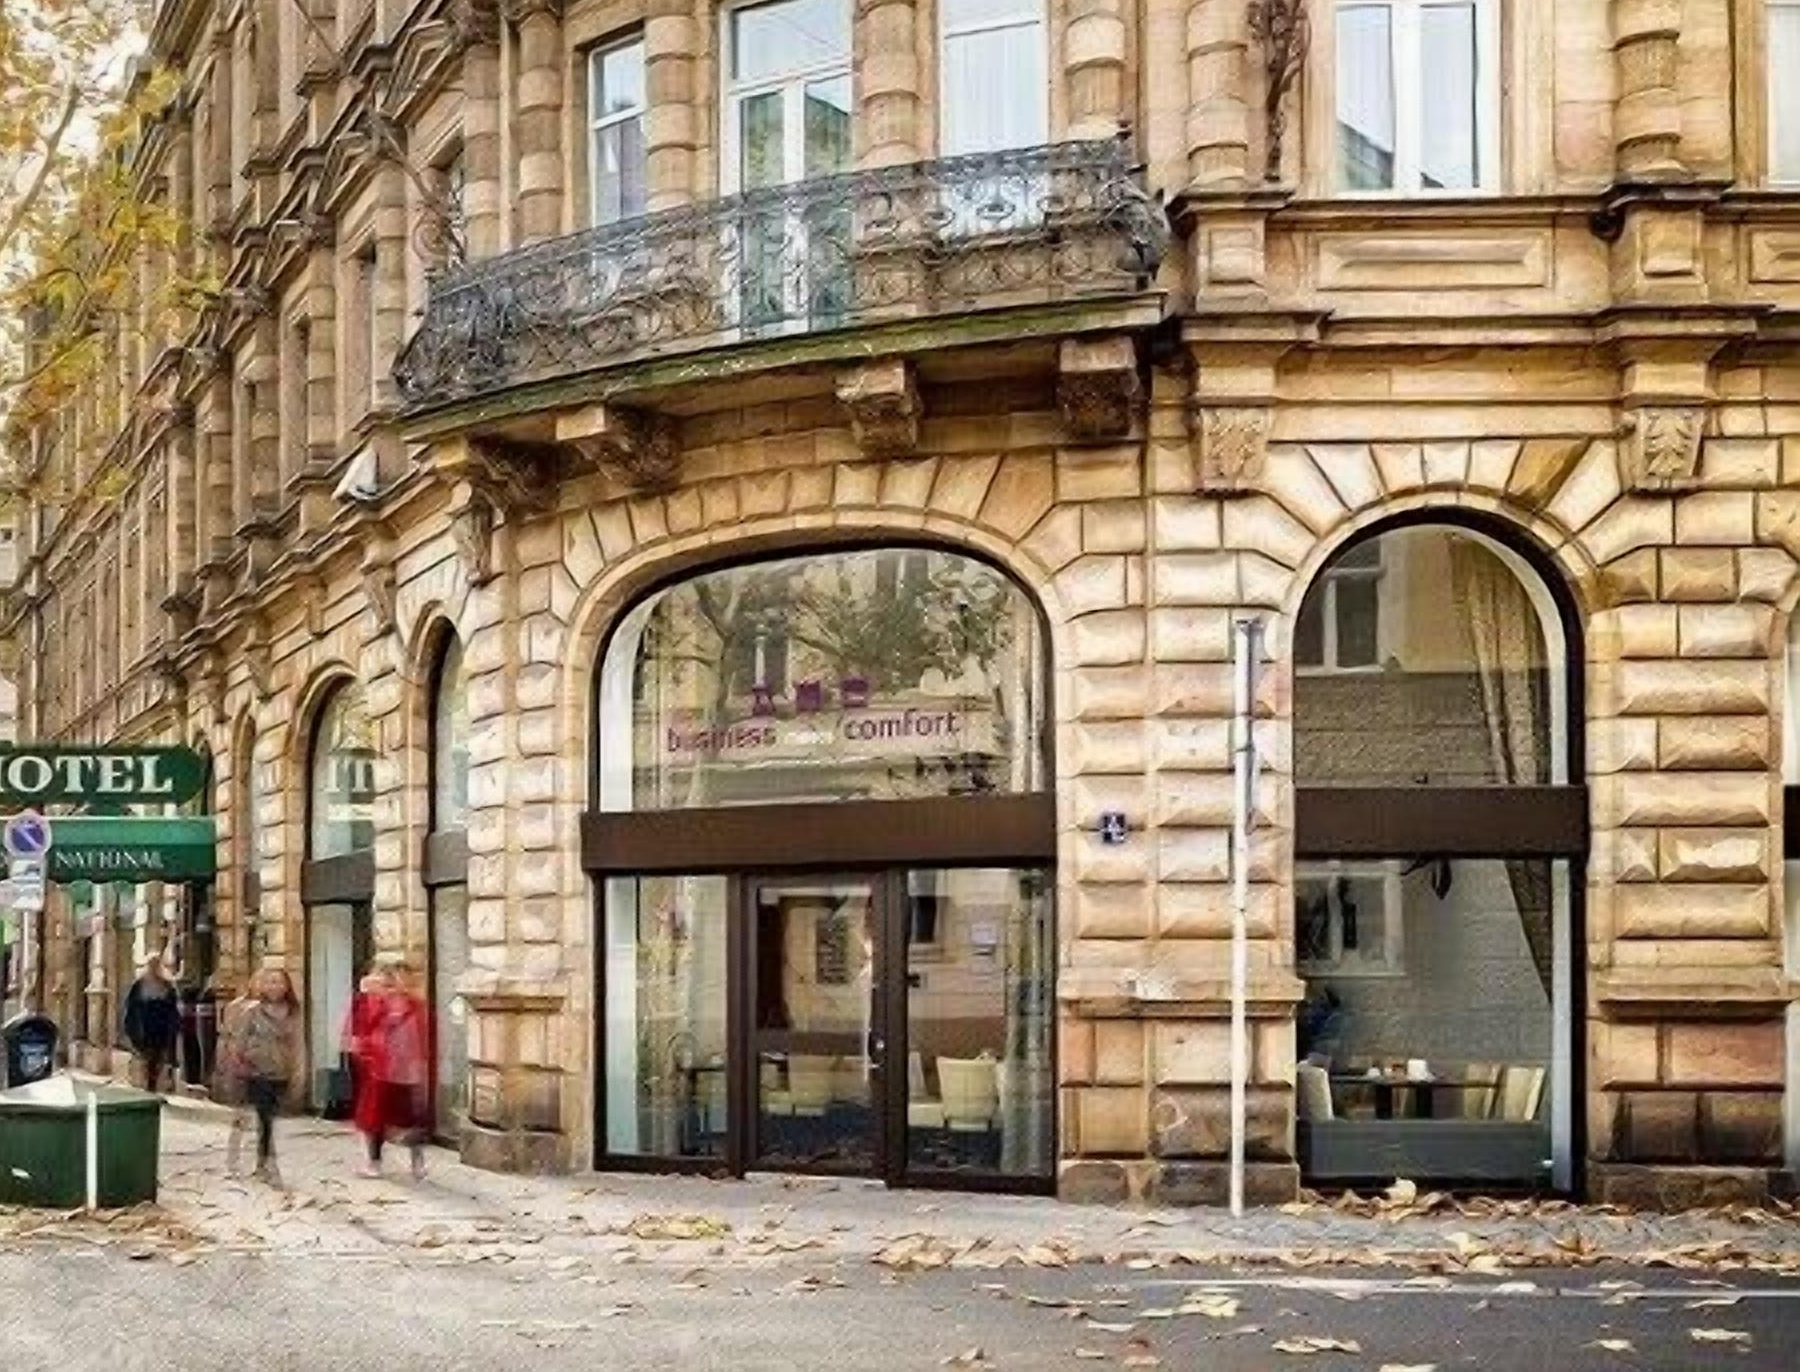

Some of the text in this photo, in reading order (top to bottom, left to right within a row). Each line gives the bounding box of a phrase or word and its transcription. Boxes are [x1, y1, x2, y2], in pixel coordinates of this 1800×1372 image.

[667, 708, 960, 752] bsiness comfort
[56, 851, 164, 869] NATIONAL
